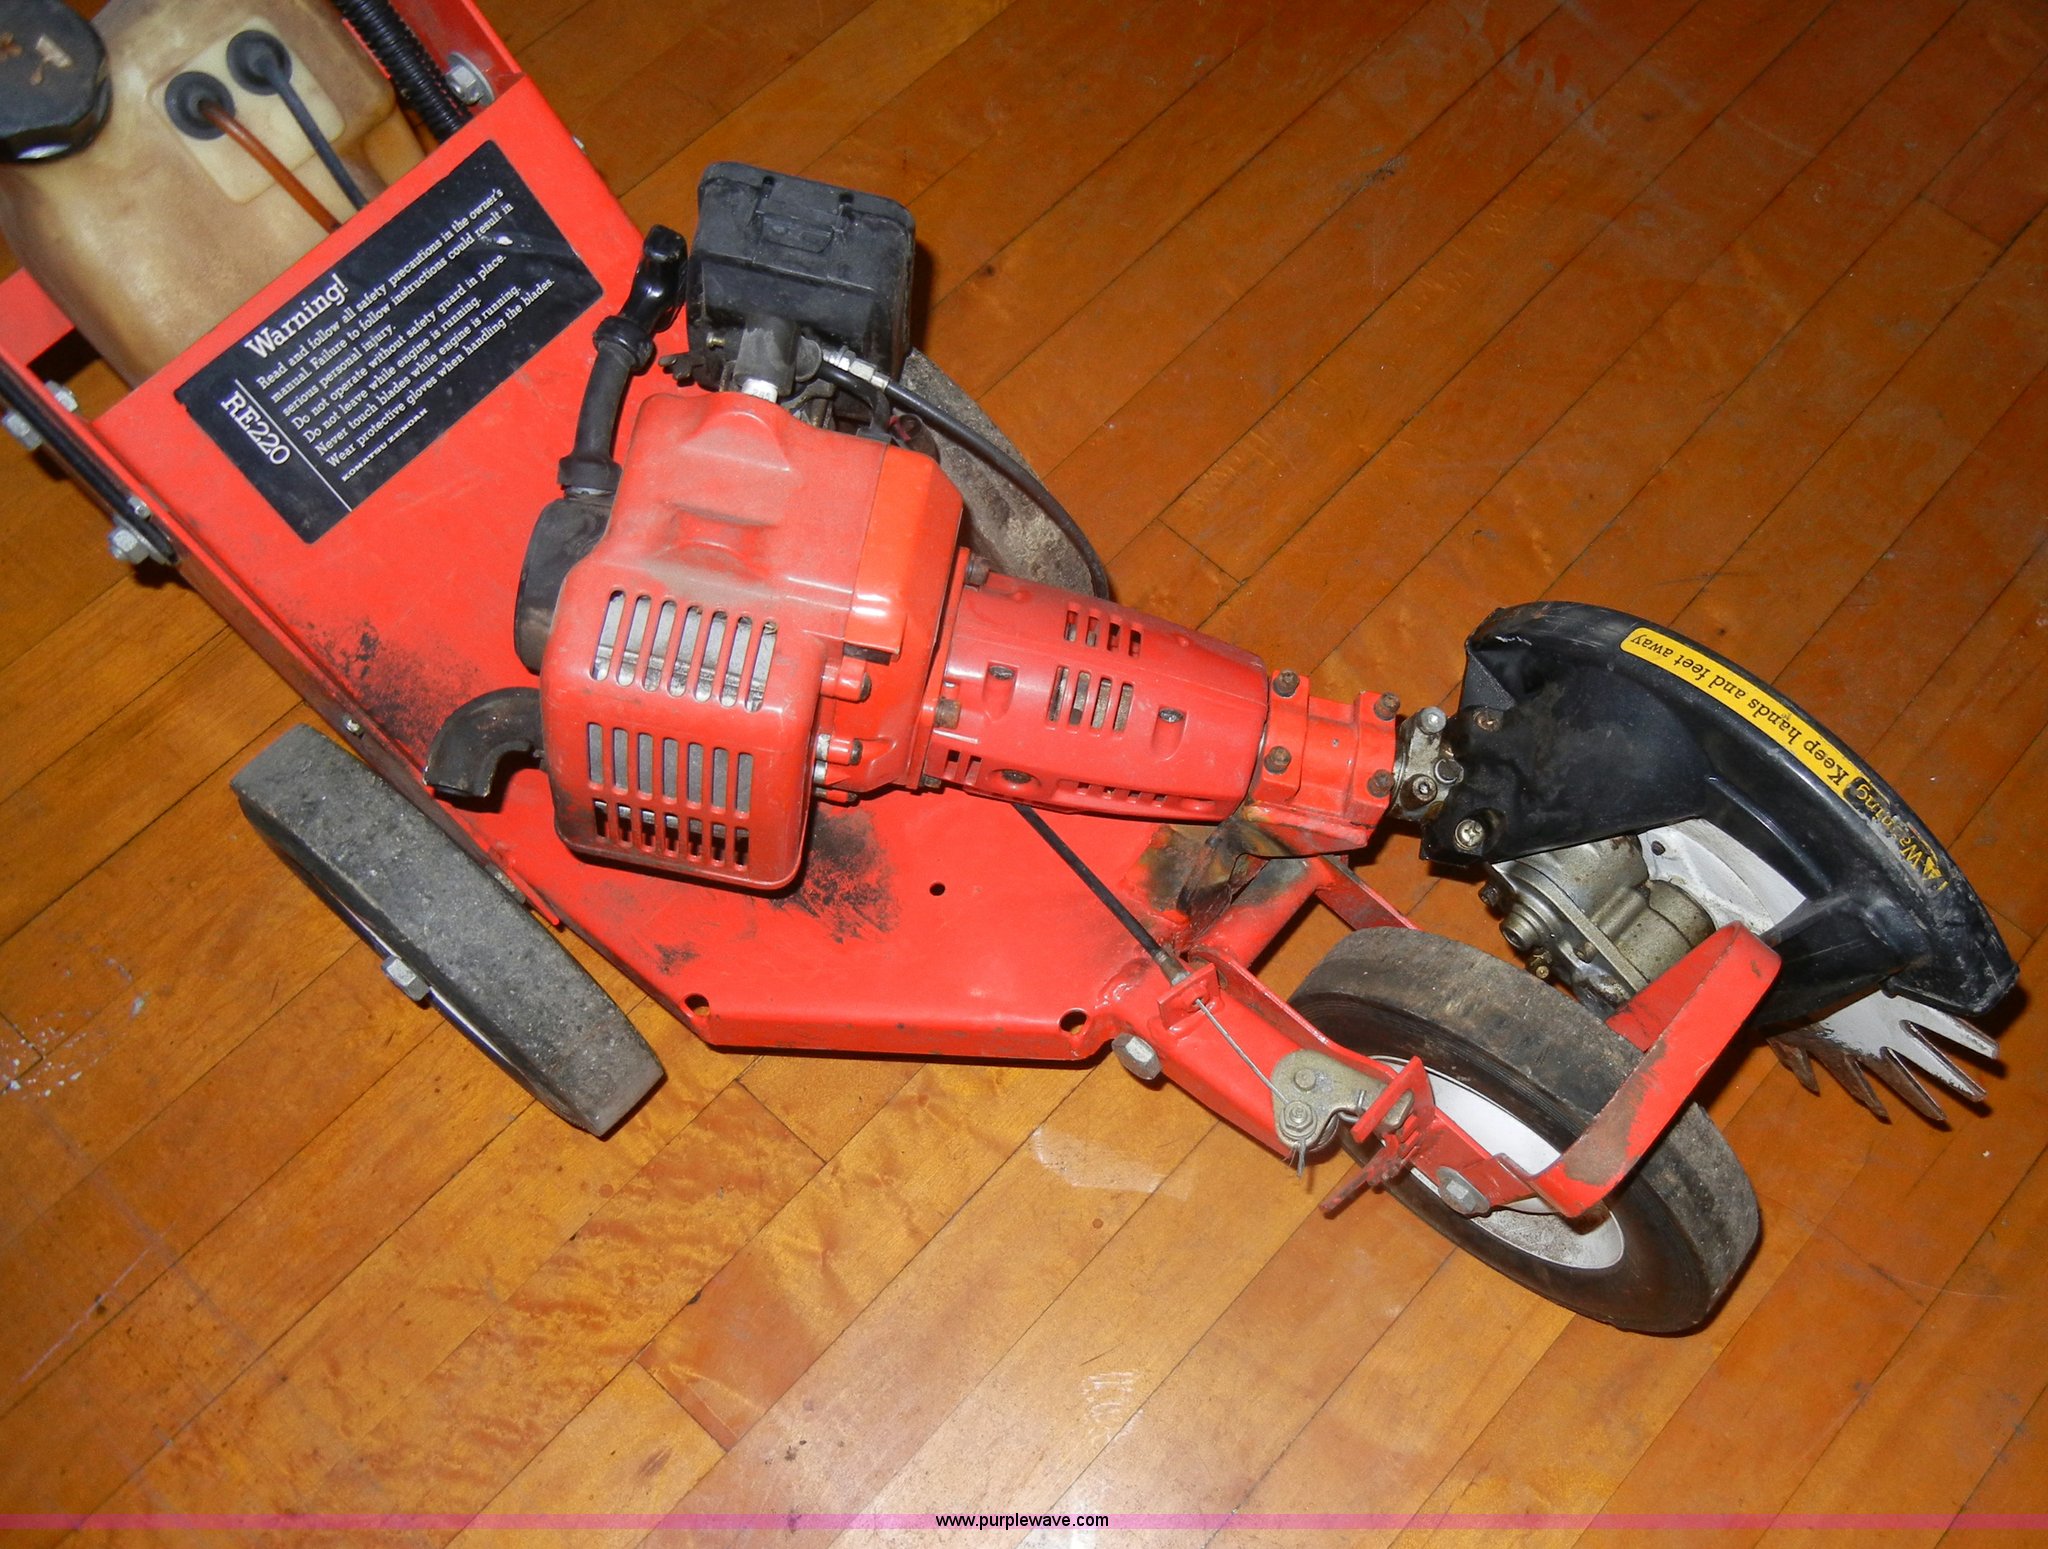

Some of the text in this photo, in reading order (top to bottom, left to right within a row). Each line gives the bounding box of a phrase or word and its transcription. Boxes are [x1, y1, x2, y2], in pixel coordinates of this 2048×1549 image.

[243, 272, 349, 358] Warning!
[255, 188, 504, 390] Read and follow all safety precautions in the owner's
[309, 339, 348, 371] Failure
[346, 329, 361, 341] to
[358, 303, 391, 332] follow
[390, 257, 448, 306] instructions
[447, 232, 476, 260] could
[474, 210, 502, 238] result
[500, 203, 514, 215] in
[282, 324, 396, 417] serious personal injury.
[291, 254, 507, 430] Do not operate without safety guard in place.
[302, 297, 482, 444] Do not leave while engine is running.
[314, 285, 521, 457] Never touch blades while engine is running.
[325, 278, 555, 467] Wear protective gloves when handling the blades.
[220, 390, 291, 465] RE220
[341, 441, 388, 482] KOMATSU
[1630, 634, 1674, 658] away
[1673, 654, 1711, 681] feet
[1708, 674, 1747, 700] and
[1747, 698, 1802, 745] hands
[1803, 739, 1849, 786] Keep
